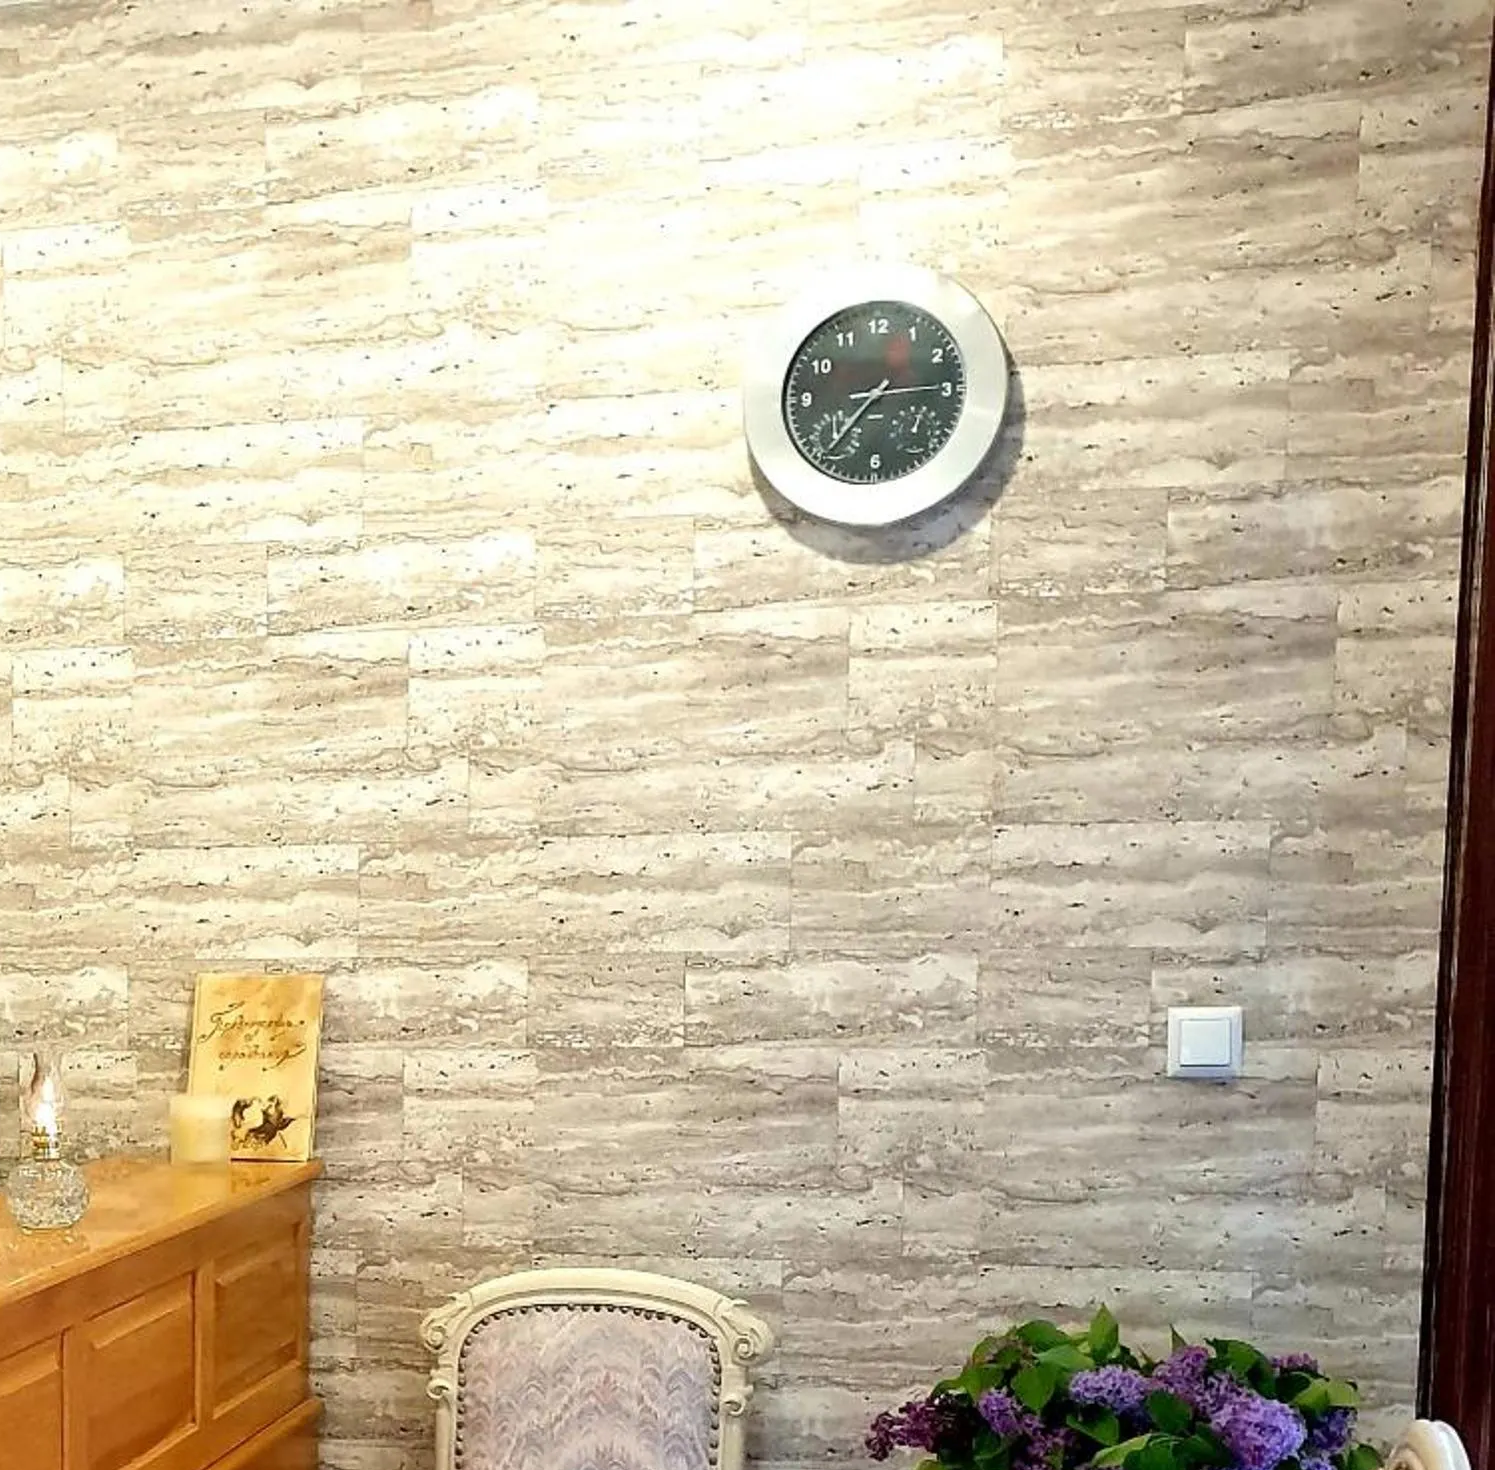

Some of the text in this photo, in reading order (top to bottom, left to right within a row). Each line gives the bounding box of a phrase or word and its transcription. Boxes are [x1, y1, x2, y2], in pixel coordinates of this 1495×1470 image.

[868, 318, 889, 335] 12
[908, 326, 917, 341] 1
[836, 332, 854, 347] 11
[931, 348, 943, 364] 2
[811, 358, 832, 374] 10
[941, 381, 952, 397] 3
[801, 392, 812, 407] 9
[869, 453, 881, 469] 6
